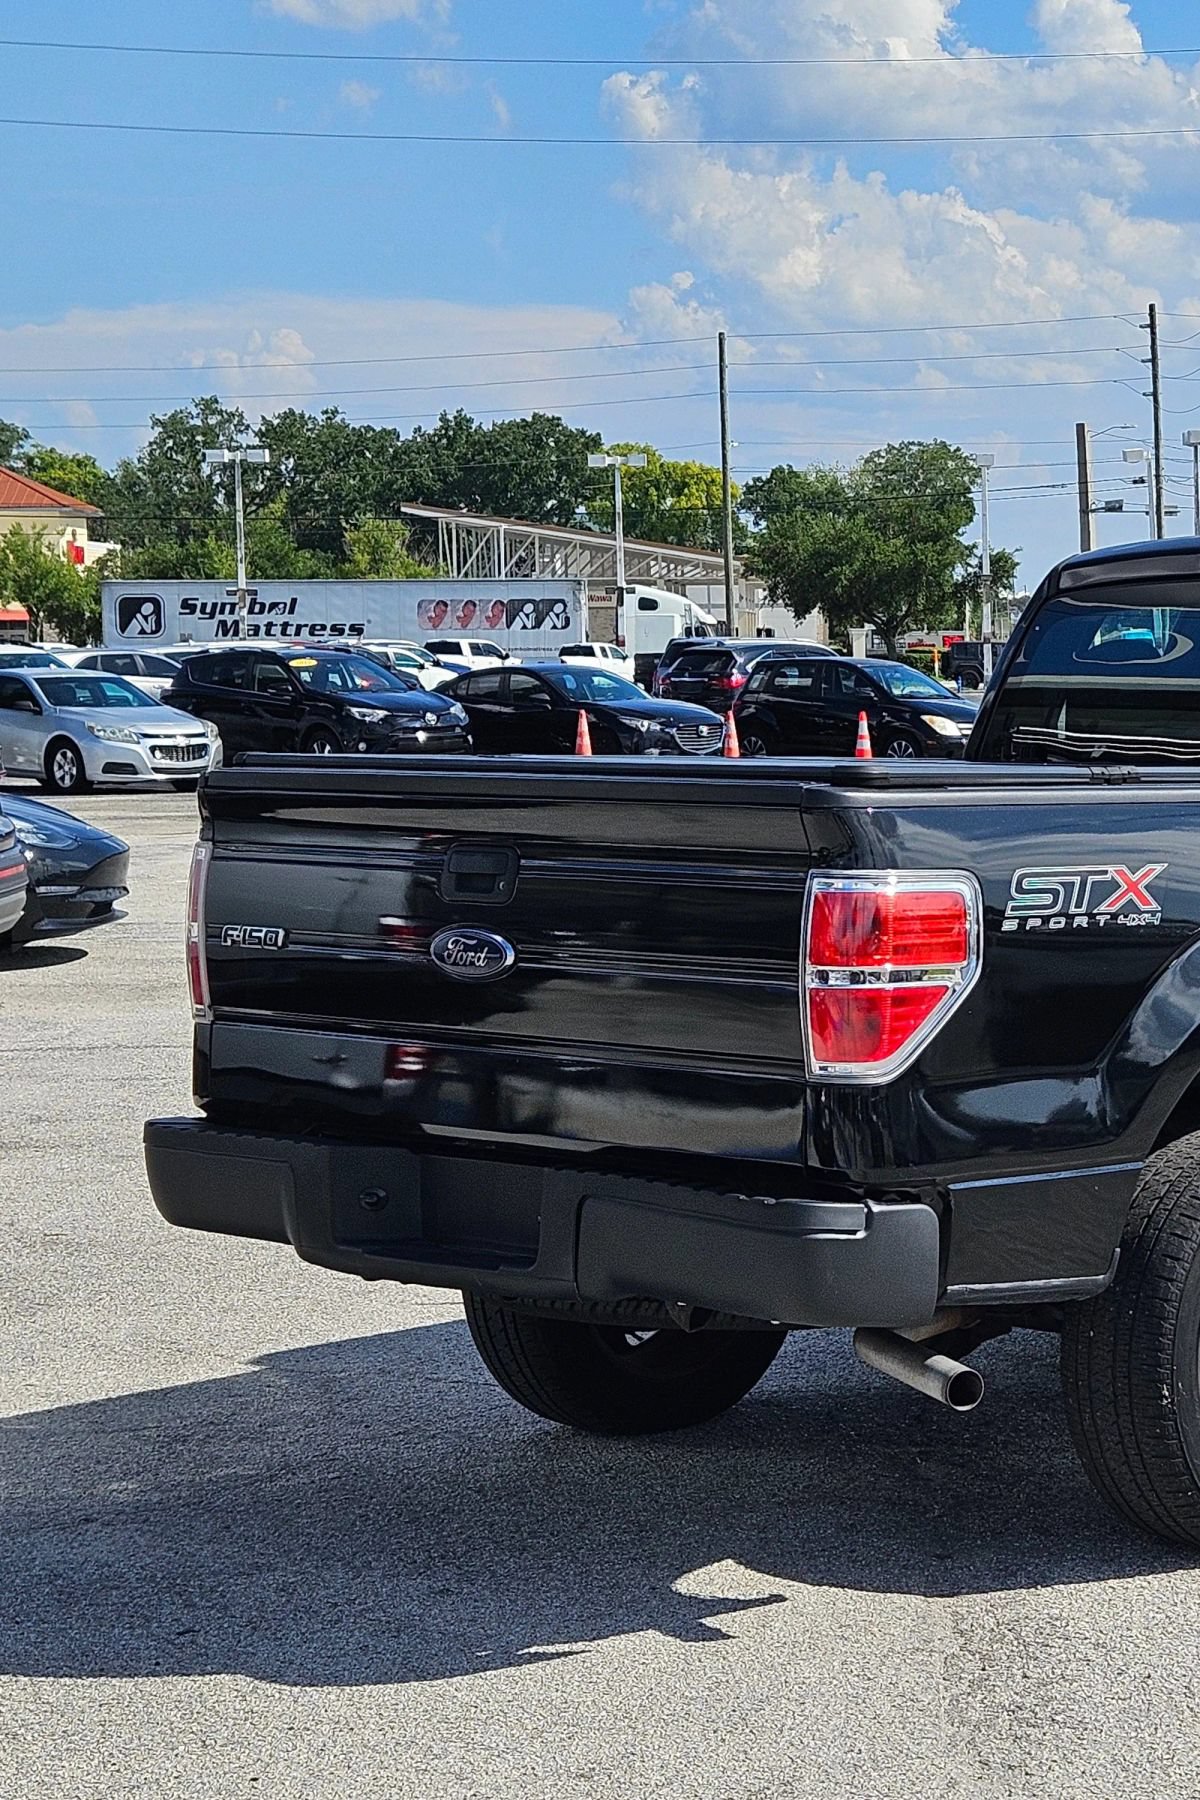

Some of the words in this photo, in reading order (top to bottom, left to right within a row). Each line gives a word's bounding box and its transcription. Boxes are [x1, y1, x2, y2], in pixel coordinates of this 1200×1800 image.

[214, 619, 366, 638] Mattress
[1004, 863, 1169, 917] STX
[1001, 914, 1111, 932] SPORT
[221, 924, 286, 950] F-150
[443, 936, 489, 967] Ford
